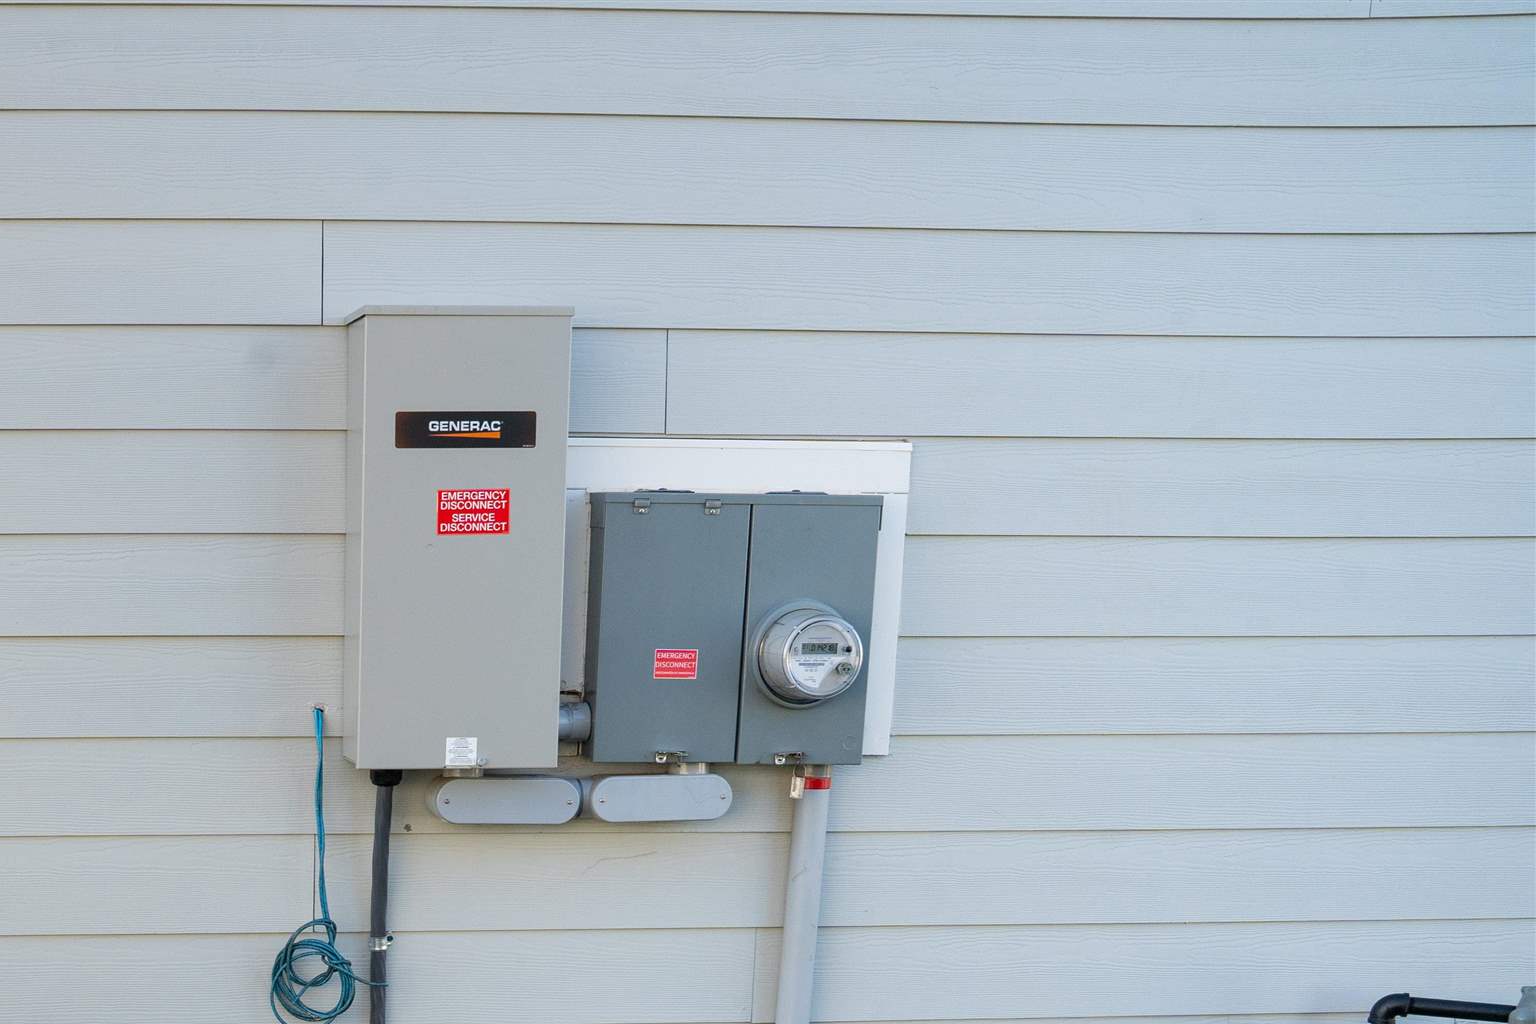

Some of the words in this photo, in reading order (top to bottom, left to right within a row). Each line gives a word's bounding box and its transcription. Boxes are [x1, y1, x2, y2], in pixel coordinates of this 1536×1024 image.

[428, 421, 501, 431] GENERAC
[441, 491, 506, 500] EMERGENCY
[440, 501, 506, 510] DISCONNECT
[452, 513, 495, 522] SERVICE
[440, 523, 506, 532] DISCONNECT
